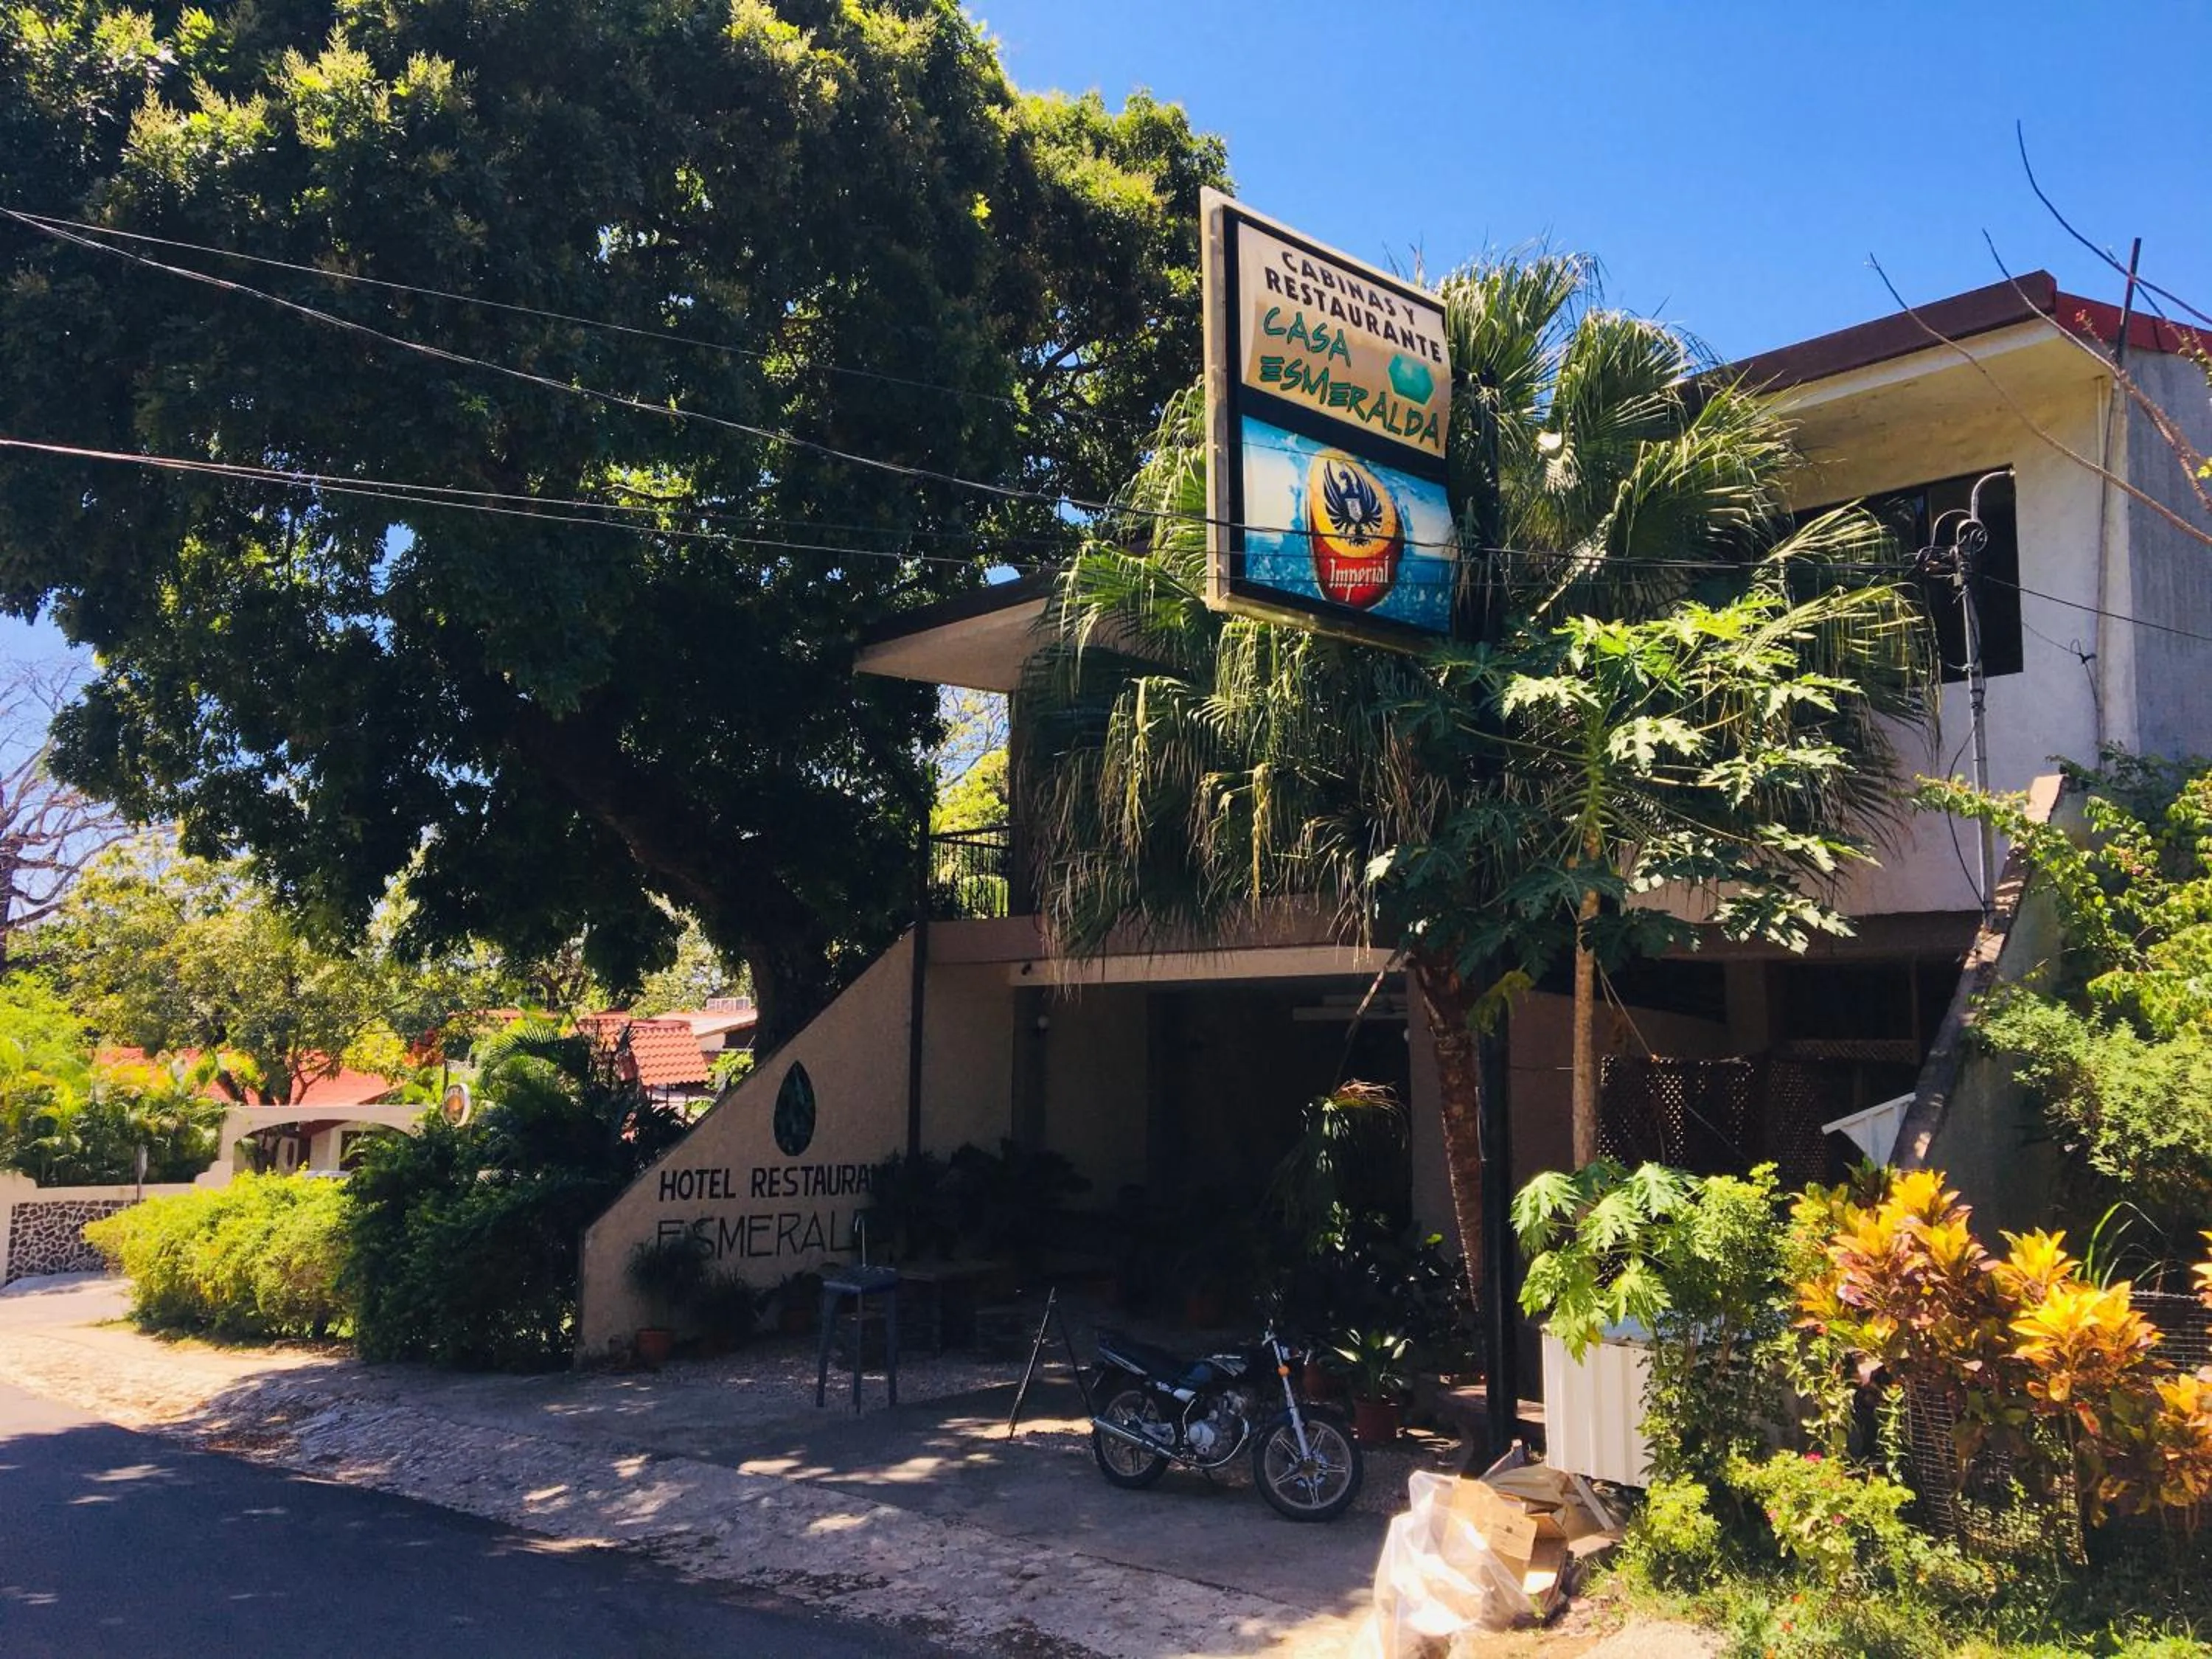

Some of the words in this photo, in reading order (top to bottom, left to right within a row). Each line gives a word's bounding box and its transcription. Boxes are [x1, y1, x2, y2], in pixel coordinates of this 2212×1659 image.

[1265, 265, 1441, 364] RESTAURANTE
[1281, 251, 1396, 315] CABINAS
[1401, 305, 1415, 326] Y
[1262, 306, 1352, 368] CASA
[1259, 355, 1440, 449] ESMERALDA
[1329, 555, 1390, 602] Imperial
[659, 1168, 737, 1202] HOTEL
[751, 1164, 872, 1199] RESTAURA
[657, 1208, 863, 1259] ESMERAL
